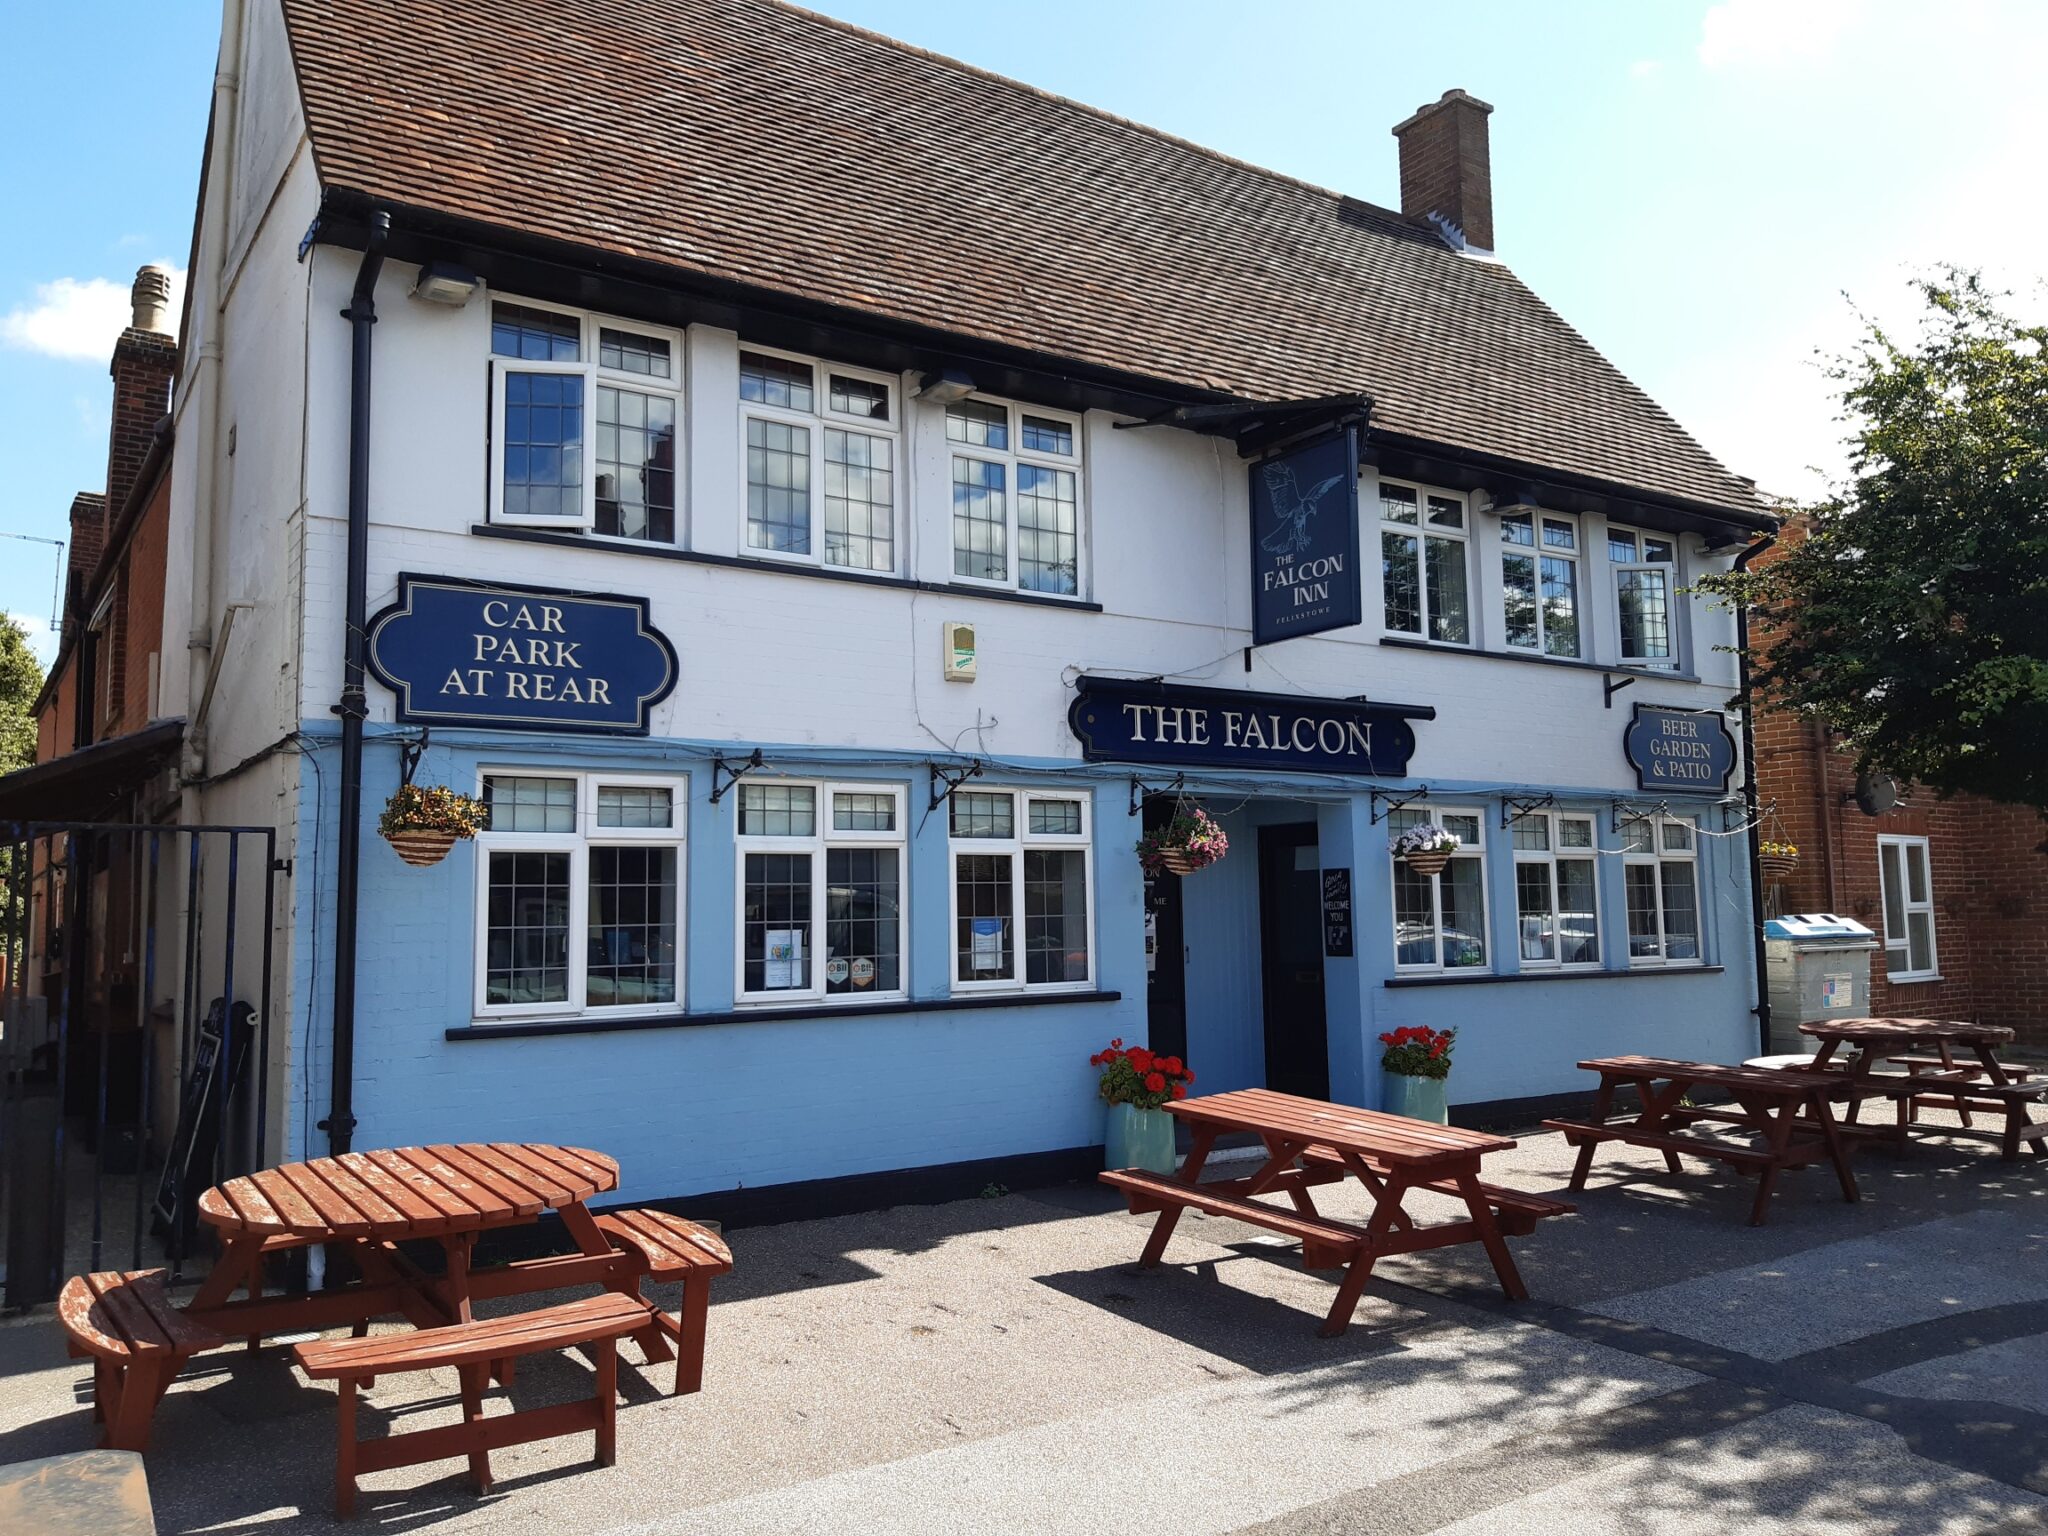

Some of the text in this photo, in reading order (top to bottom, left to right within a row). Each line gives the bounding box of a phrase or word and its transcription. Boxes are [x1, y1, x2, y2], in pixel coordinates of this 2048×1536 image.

[1275, 554, 1294, 566] THE
[1263, 554, 1344, 592] FALCON
[1293, 581, 1329, 606] INN
[482, 600, 566, 633] CAR
[473, 634, 583, 670] PARK
[439, 667, 612, 705] AT REAR
[1123, 703, 1373, 756] THE FALCON
[1661, 719, 1698, 738] BEER
[1650, 738, 1711, 759] GARDEN
[1652, 760, 1711, 780] & PATIO
[1324, 899, 1350, 911] WELCOME
[1329, 912, 1344, 922] YOU
